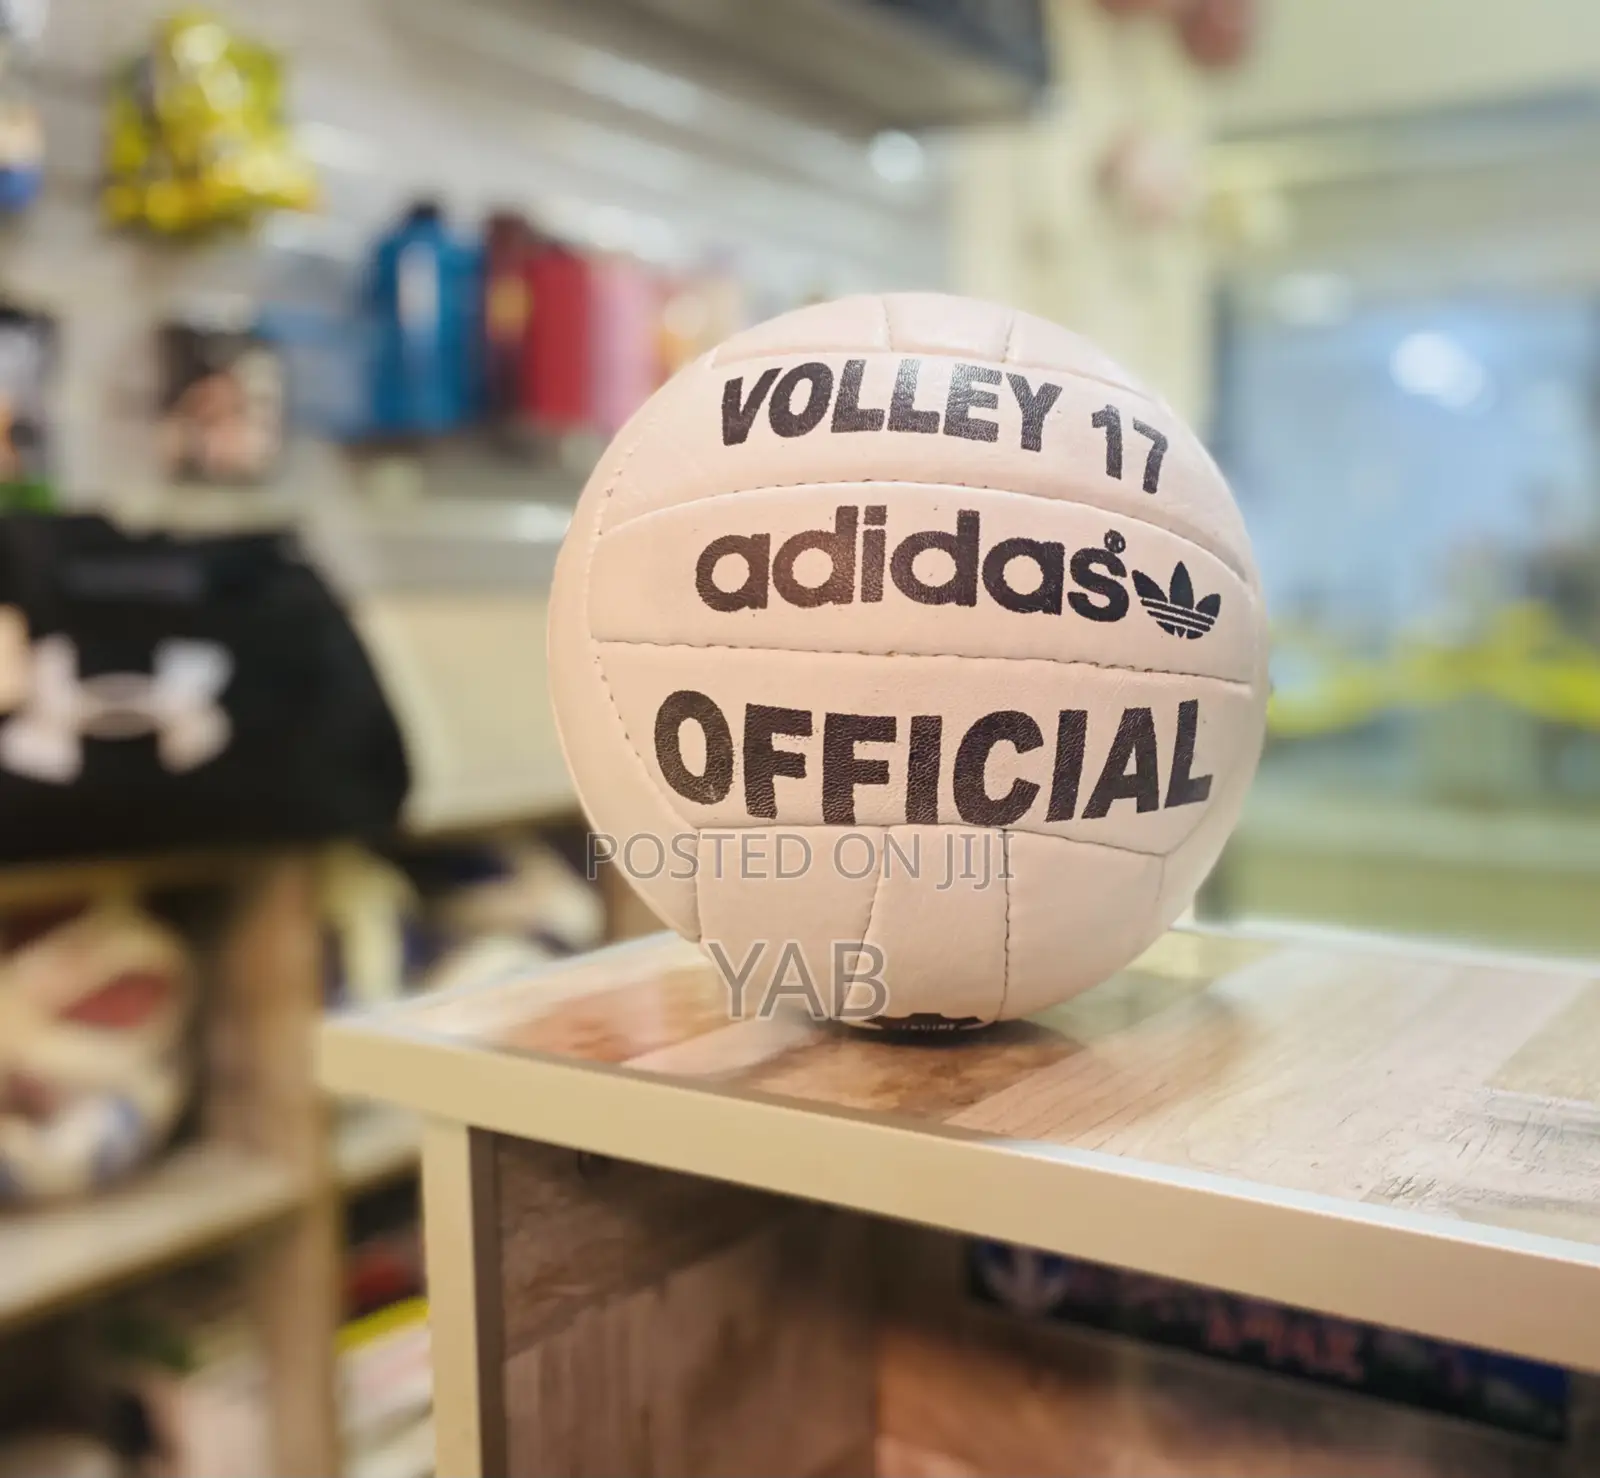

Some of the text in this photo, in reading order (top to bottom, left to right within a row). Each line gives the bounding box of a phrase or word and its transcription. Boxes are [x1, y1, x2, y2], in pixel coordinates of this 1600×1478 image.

[721, 359, 1168, 494] VOLLEY 17
[654, 690, 1213, 826] OFFICIAL
